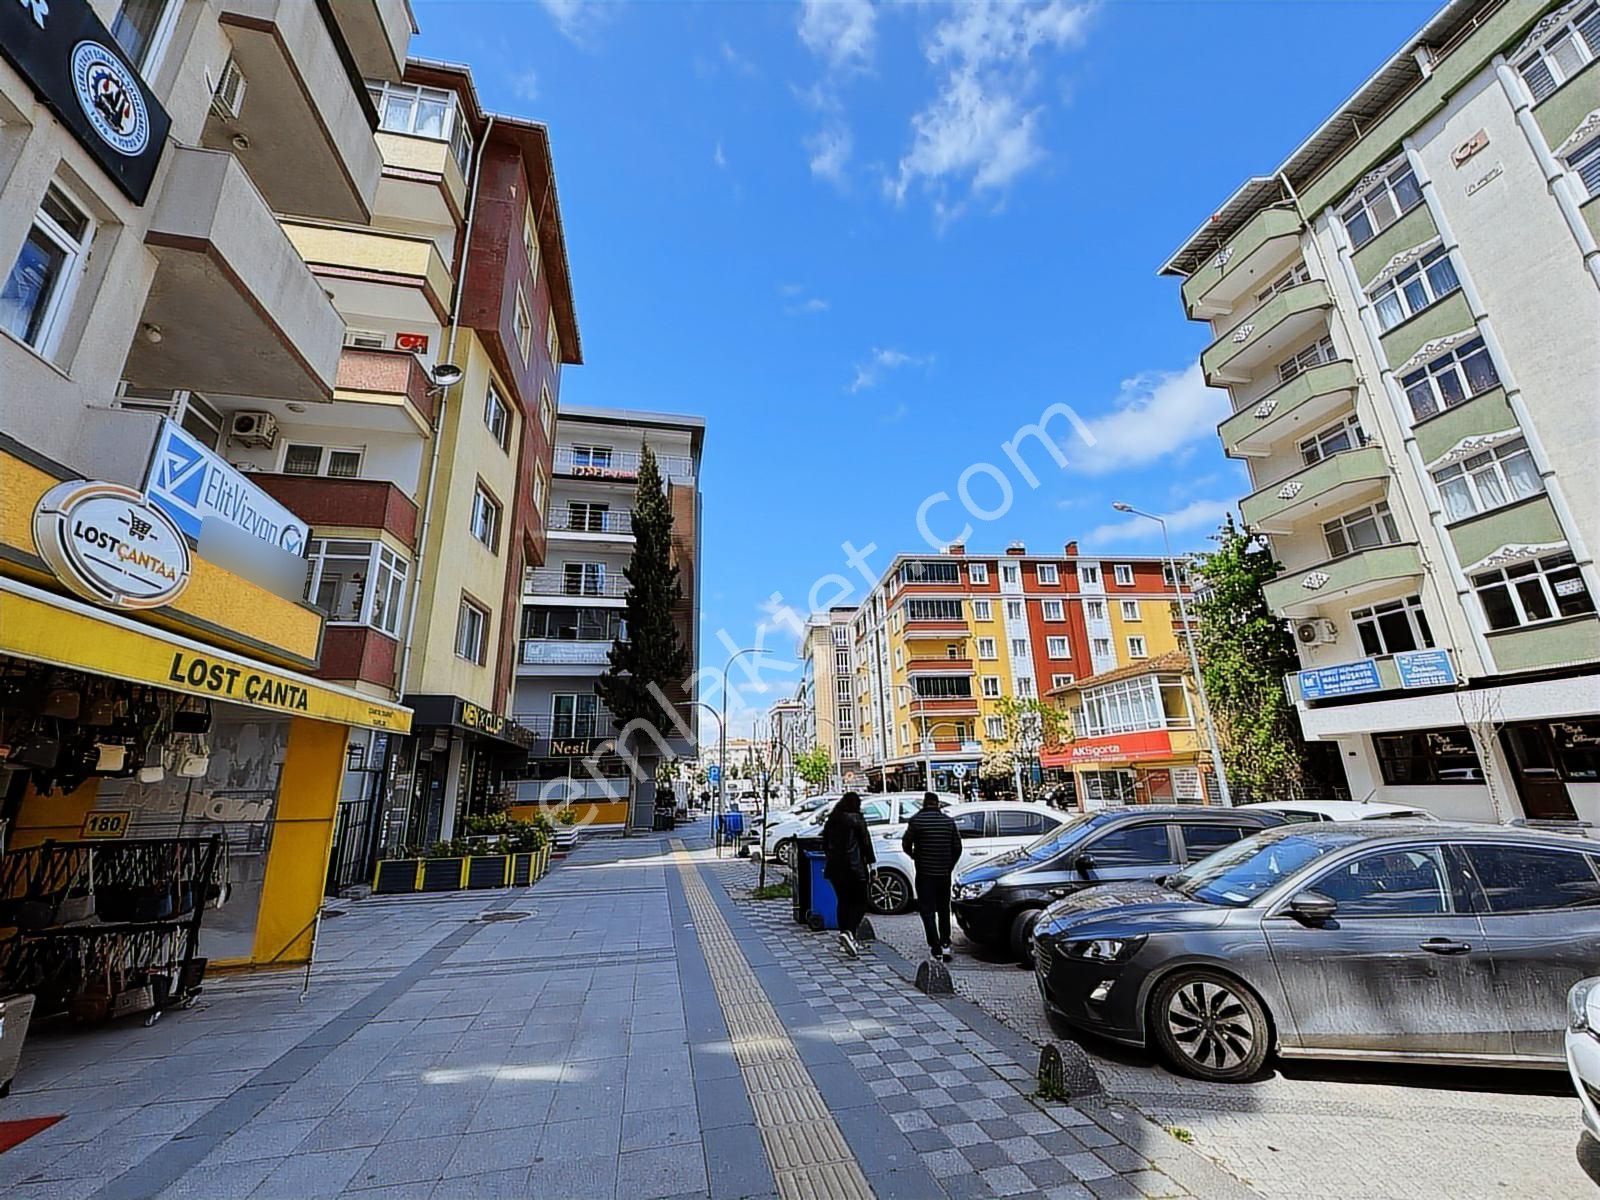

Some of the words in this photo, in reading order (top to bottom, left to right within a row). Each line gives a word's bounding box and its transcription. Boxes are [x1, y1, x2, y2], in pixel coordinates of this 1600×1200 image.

[169, 653, 240, 694] LOST
[245, 675, 307, 710] ÇANTA
[552, 739, 589, 755] Nesil
[89, 816, 121, 833] 180
